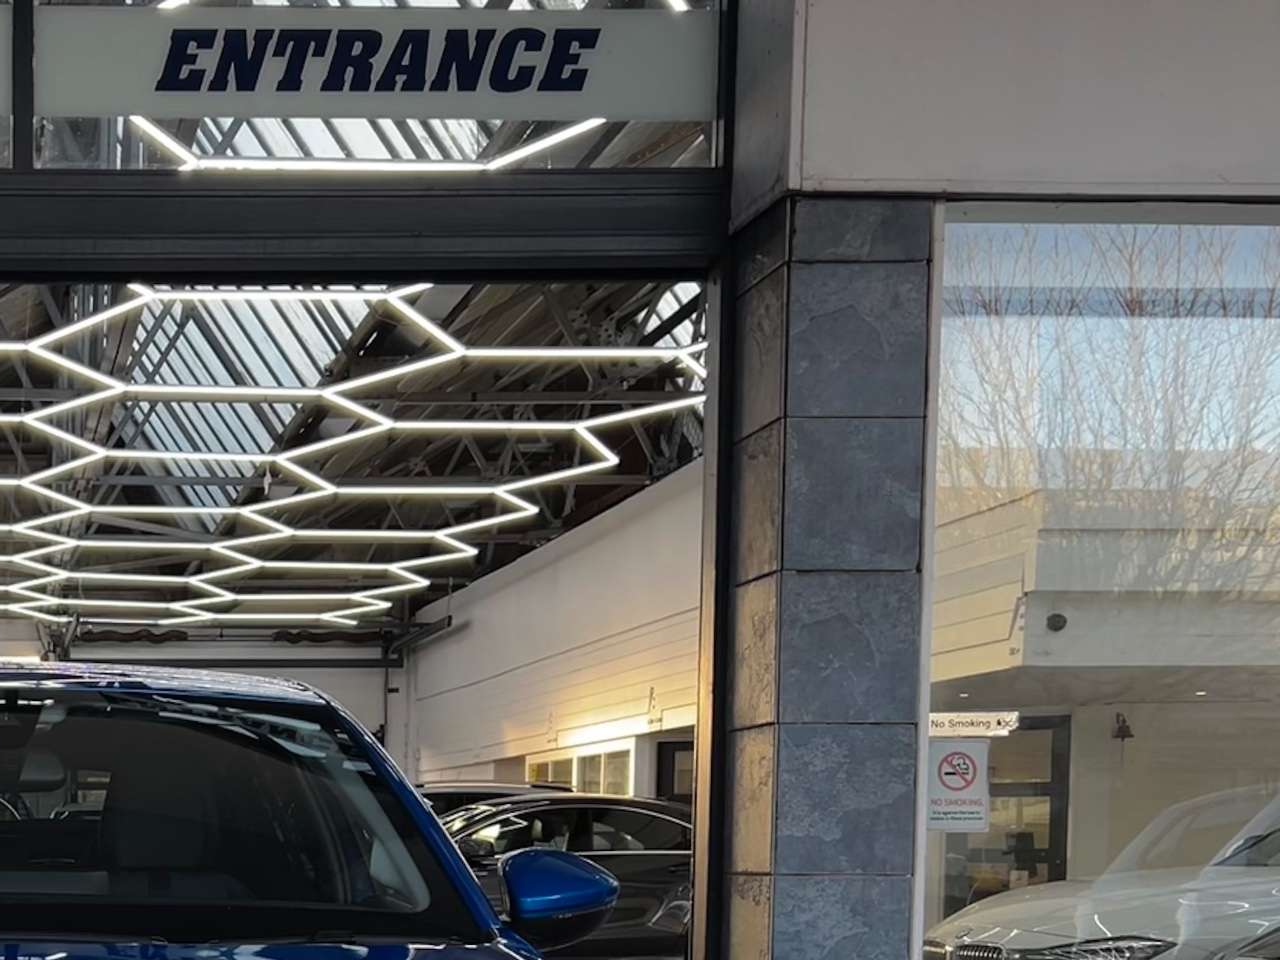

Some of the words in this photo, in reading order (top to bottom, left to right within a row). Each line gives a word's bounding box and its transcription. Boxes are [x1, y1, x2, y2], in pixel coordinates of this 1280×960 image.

[154, 27, 602, 94] ENTRANCE
[930, 719, 946, 729] No
[947, 718, 992, 730] Smoking
[930, 798, 943, 807] NO
